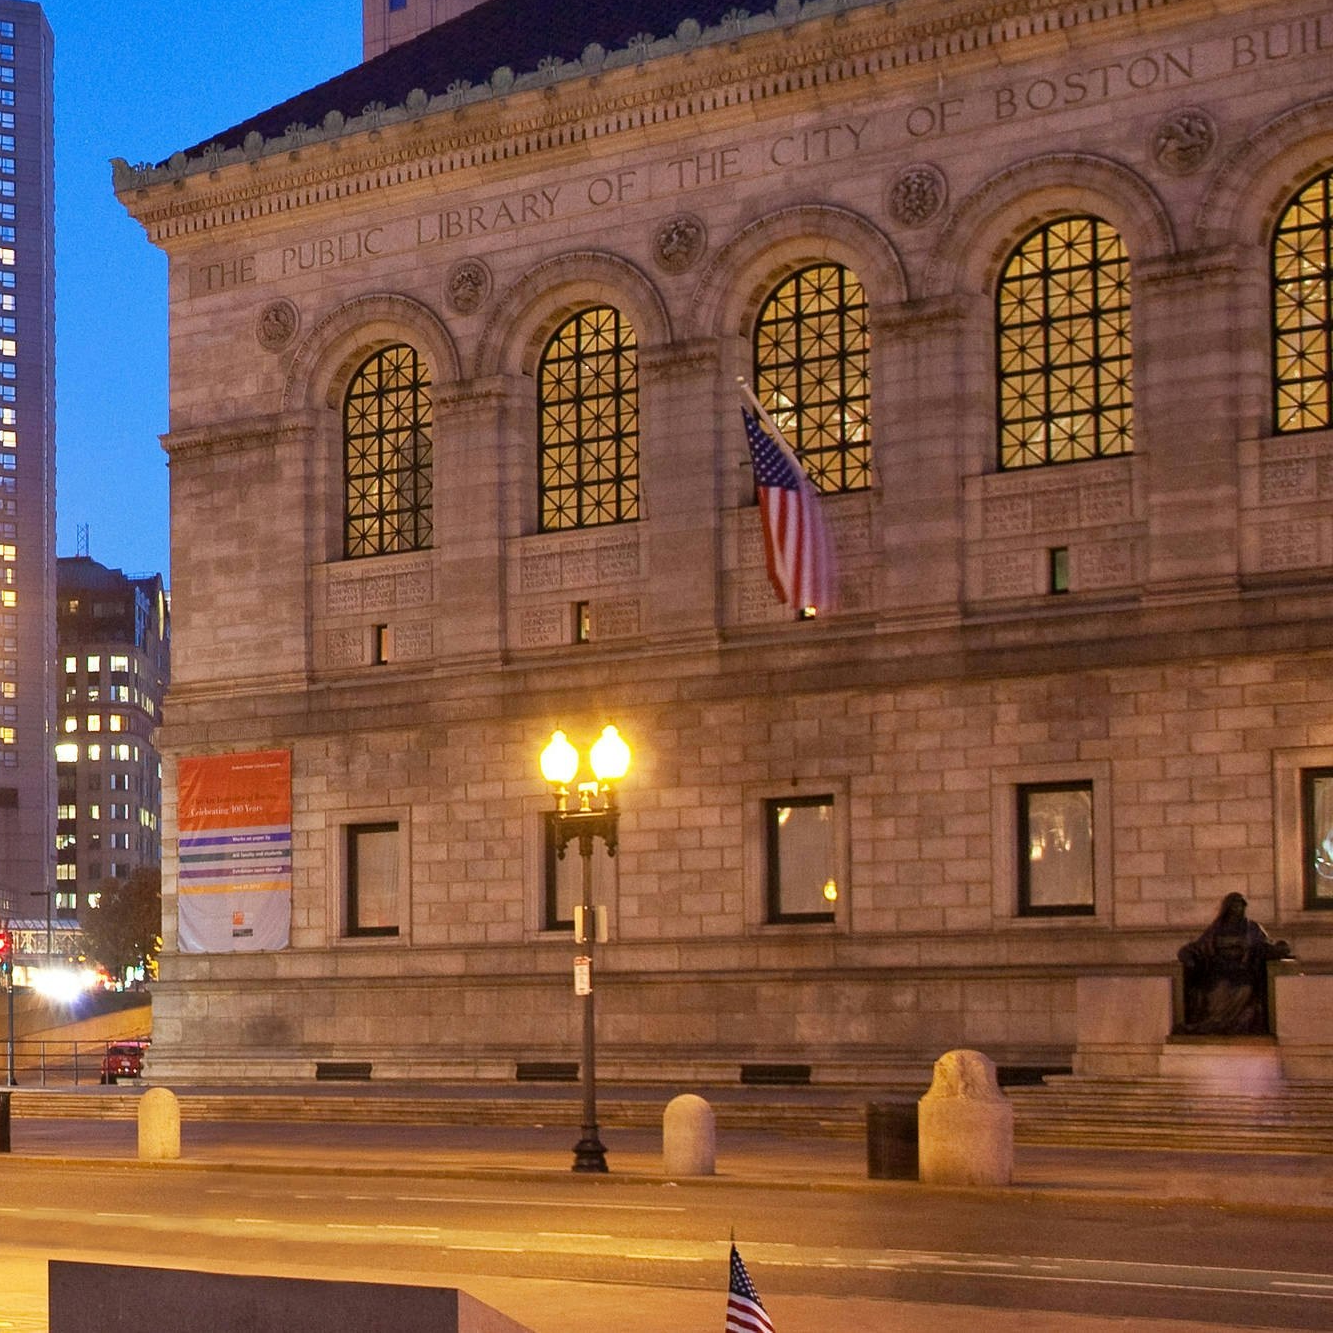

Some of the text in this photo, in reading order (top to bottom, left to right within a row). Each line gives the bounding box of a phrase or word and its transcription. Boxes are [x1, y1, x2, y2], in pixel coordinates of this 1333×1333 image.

[200, 257, 256, 292] THE
[282, 227, 384, 276] PUBLIC
[417, 186, 563, 245] LIBRARY
[588, 170, 637, 206] OF
[669, 147, 741, 189] THE
[770, 118, 870, 167] CITY
[906, 97, 965, 137] OF
[996, 47, 1195, 121] BOSTON
